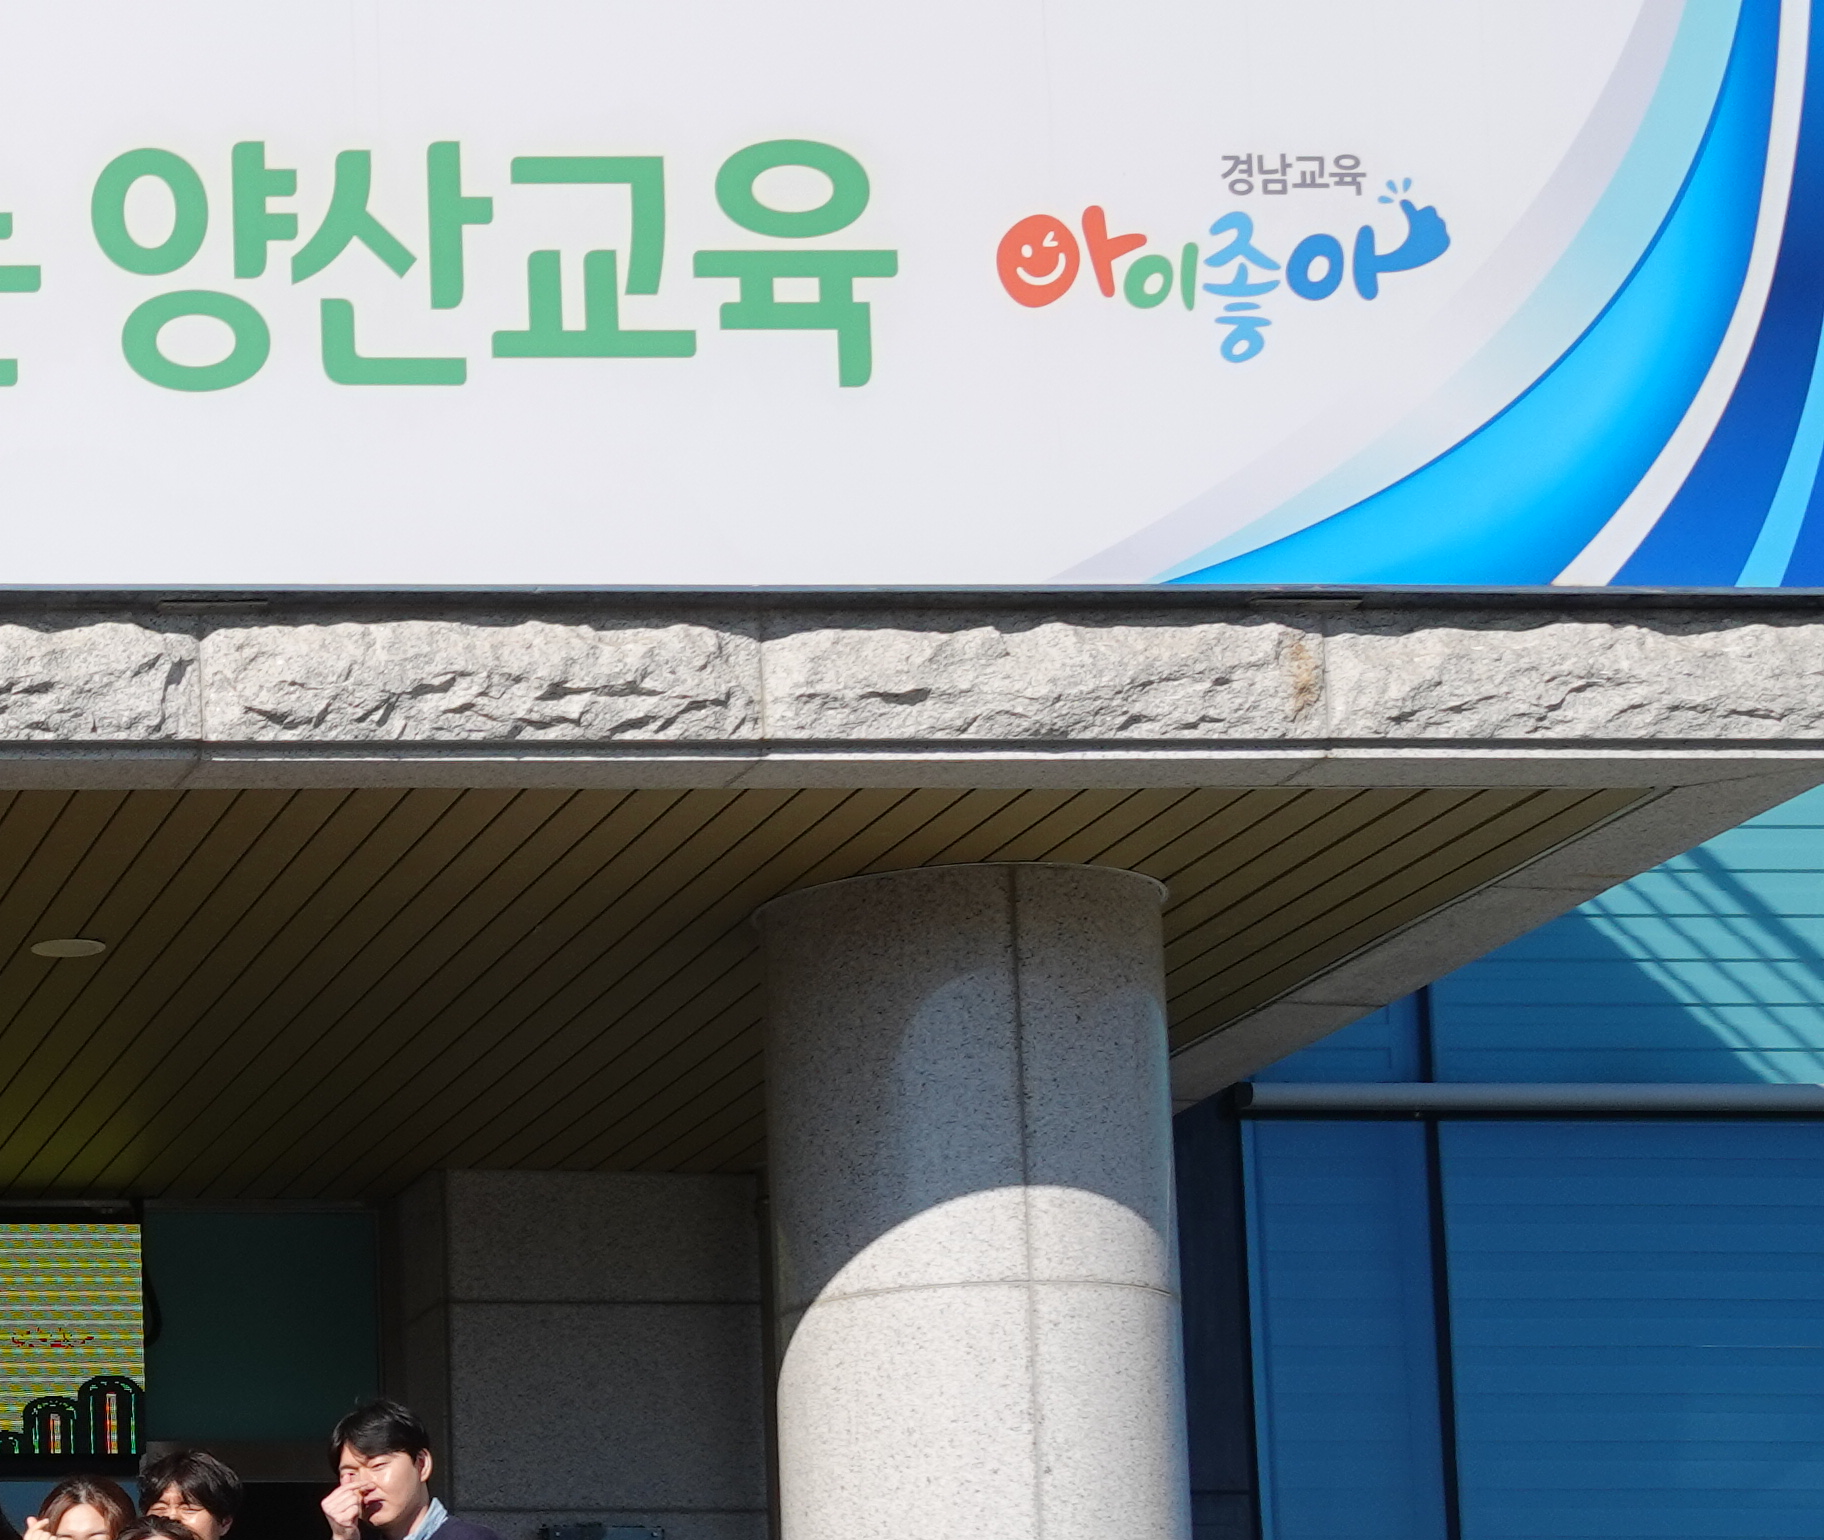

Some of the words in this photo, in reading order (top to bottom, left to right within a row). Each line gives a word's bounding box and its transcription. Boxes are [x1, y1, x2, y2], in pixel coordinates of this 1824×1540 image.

[1221, 153, 1367, 197] 경남교육
[91, 138, 899, 392] 양산교육
[996, 199, 1451, 364] 아이좋아
